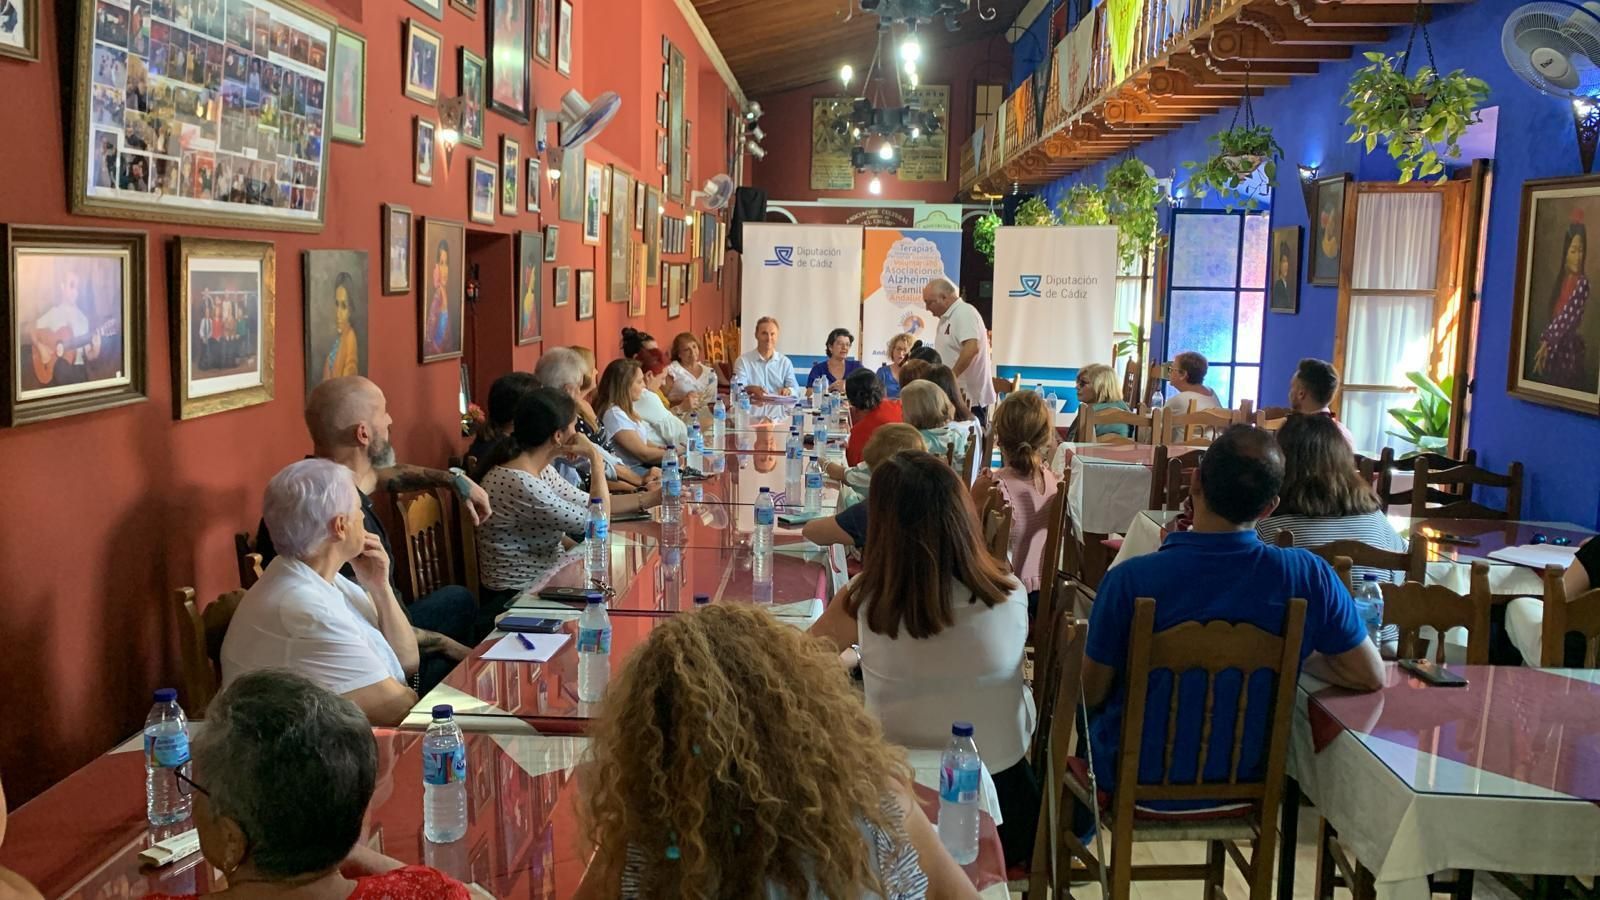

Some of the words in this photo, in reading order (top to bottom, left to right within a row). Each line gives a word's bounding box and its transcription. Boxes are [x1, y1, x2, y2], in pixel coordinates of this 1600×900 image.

[797, 246, 841, 257] Diputación
[900, 244, 933, 253] Terapias
[797, 258, 807, 268] de
[810, 258, 832, 268] Cádiz
[885, 266, 943, 275] Asociaciones
[888, 274, 930, 284] Alzheim
[1046, 274, 1098, 286] Diputación
[1045, 289, 1057, 298] de
[1061, 288, 1088, 299] Cádiz
